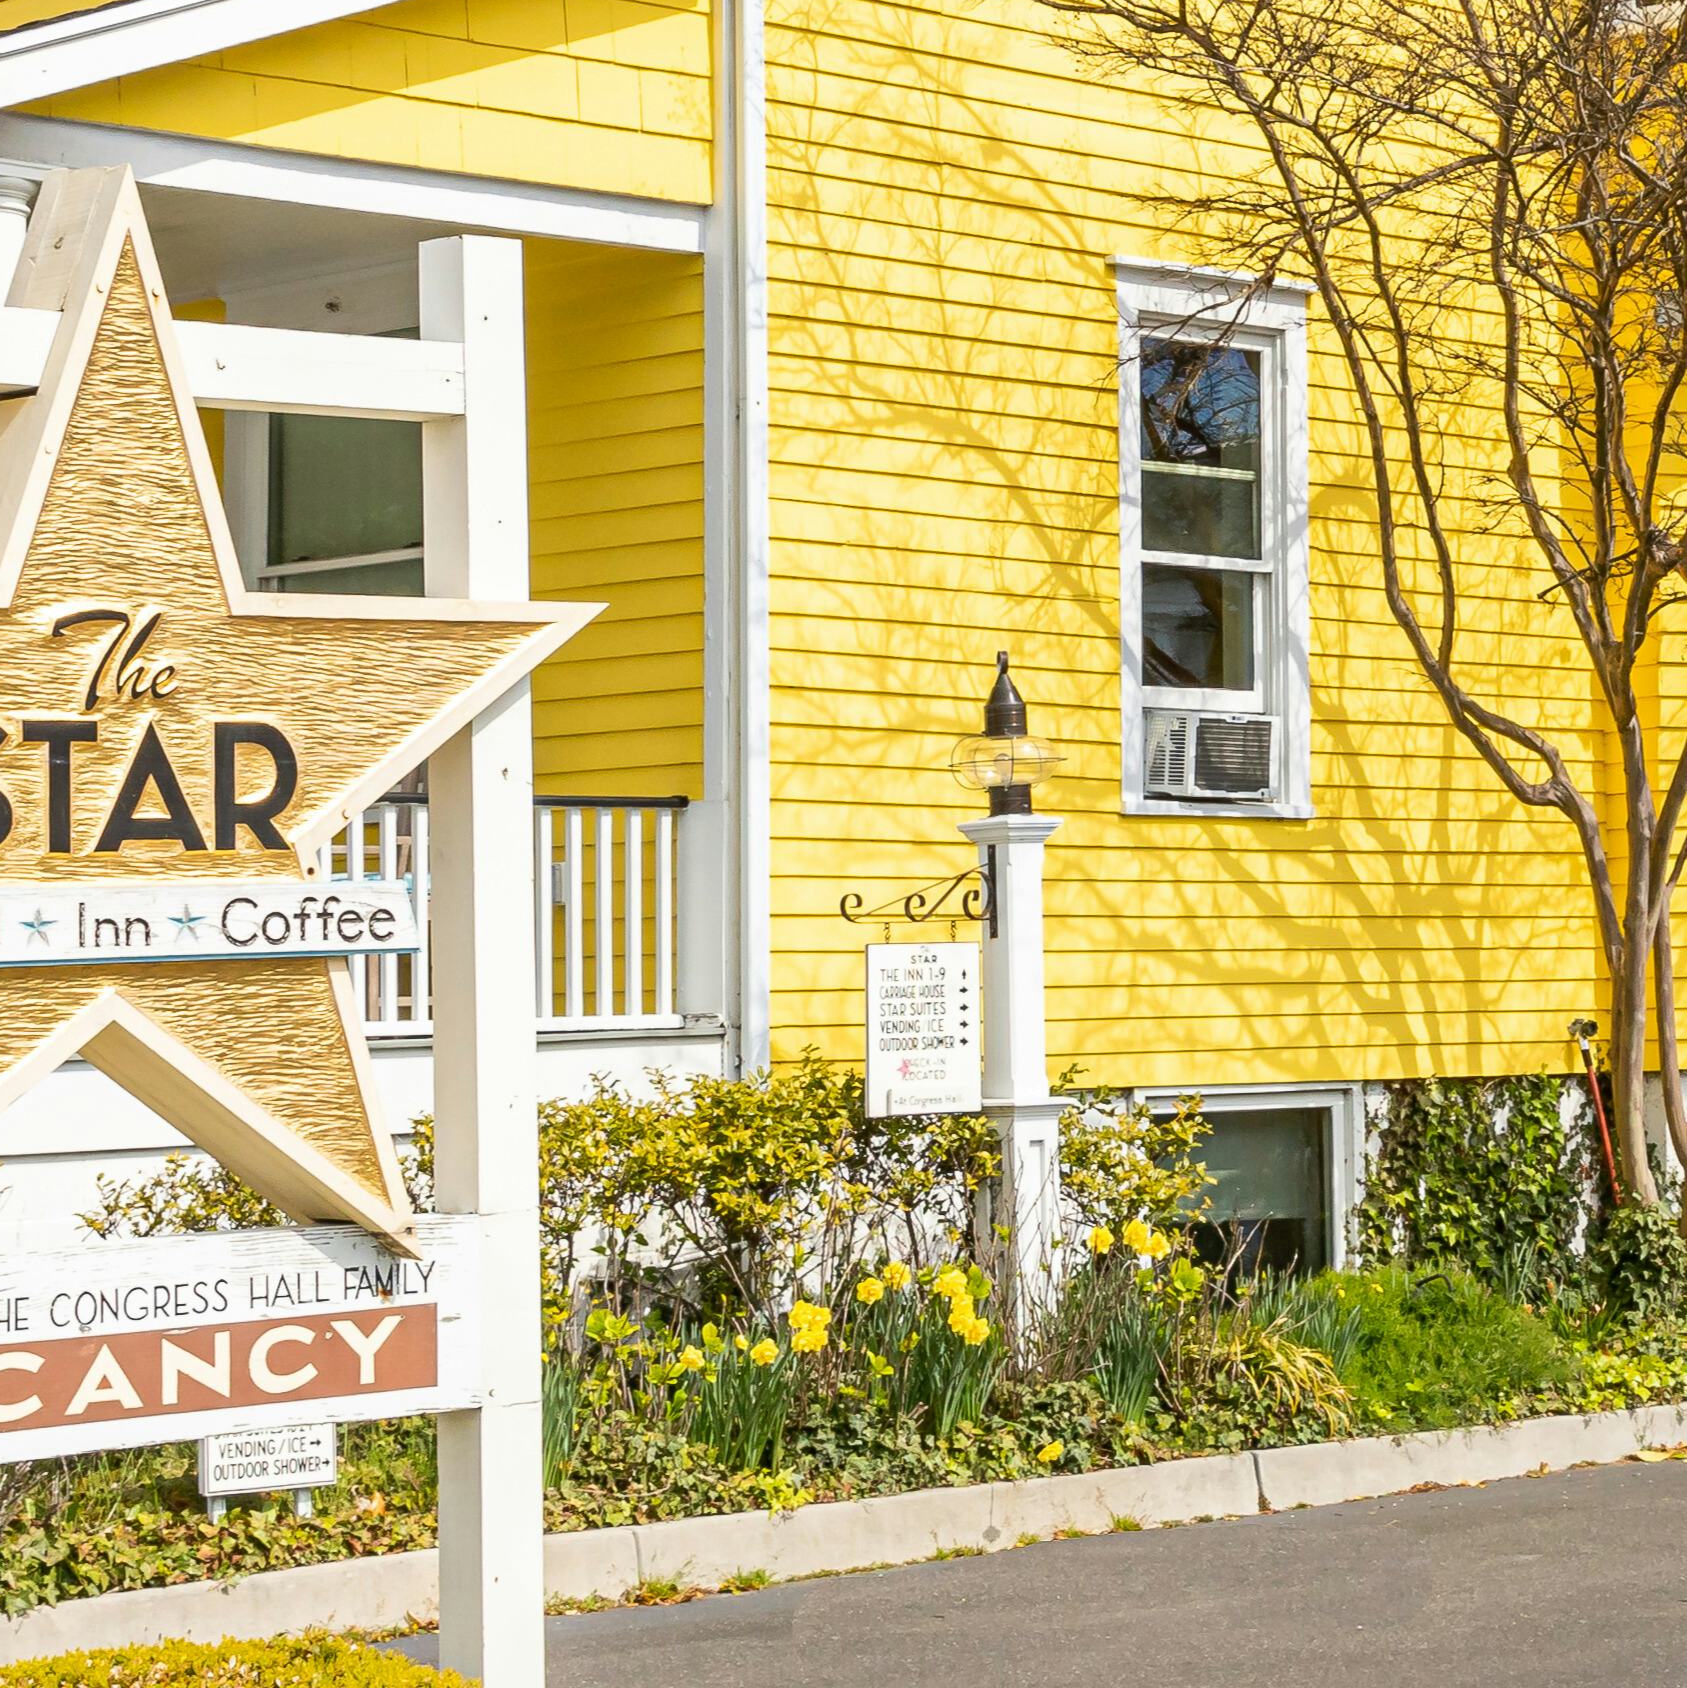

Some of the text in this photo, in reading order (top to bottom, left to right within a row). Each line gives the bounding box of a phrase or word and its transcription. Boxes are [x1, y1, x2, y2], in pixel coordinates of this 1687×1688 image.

[52, 610, 178, 711] The
[78, 902, 152, 948] Inn
[221, 896, 396, 947] Coffee
[910, 954, 938, 964] STAR
[880, 967, 946, 982] THE INN 1-9
[919, 984, 946, 999] HOUSE
[880, 1001, 946, 1017] STAR SUITES
[879, 1035, 955, 1052] OUTDOOR SHOWER
[50, 1279, 228, 1327] CONGRESS
[250, 1270, 330, 1309] HALL
[343, 1261, 435, 1301] FAMILY
[213, 1456, 321, 1482] OUTDOOR SHOWER
